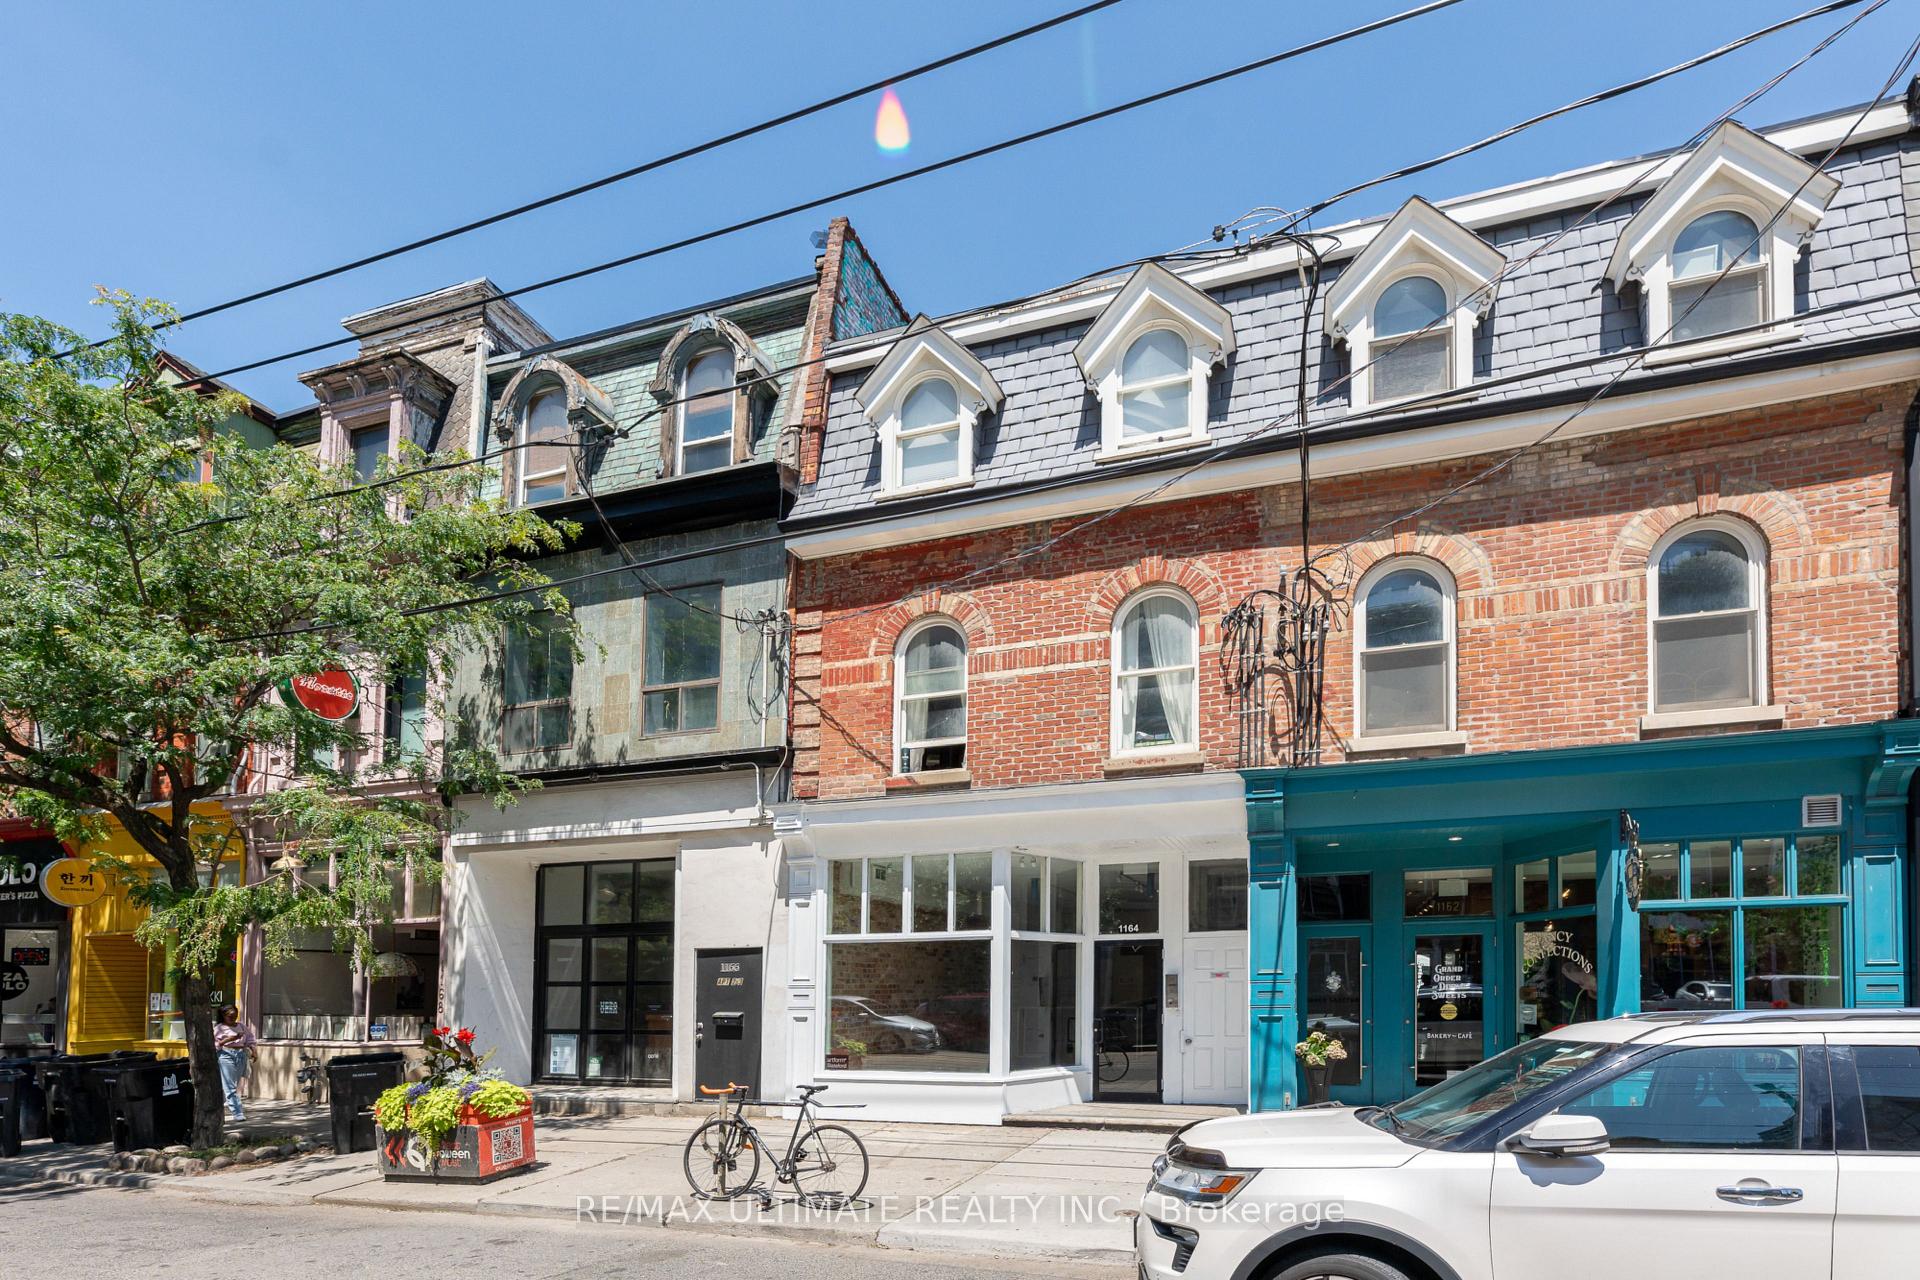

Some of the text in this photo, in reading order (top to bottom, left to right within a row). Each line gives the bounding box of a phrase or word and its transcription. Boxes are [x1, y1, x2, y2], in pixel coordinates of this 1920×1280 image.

[17, 891, 38, 899] PIZZA
[1118, 924, 1139, 932] 1164
[1435, 964, 1463, 974] GRAND
[1433, 974, 1461, 982] ORDER
